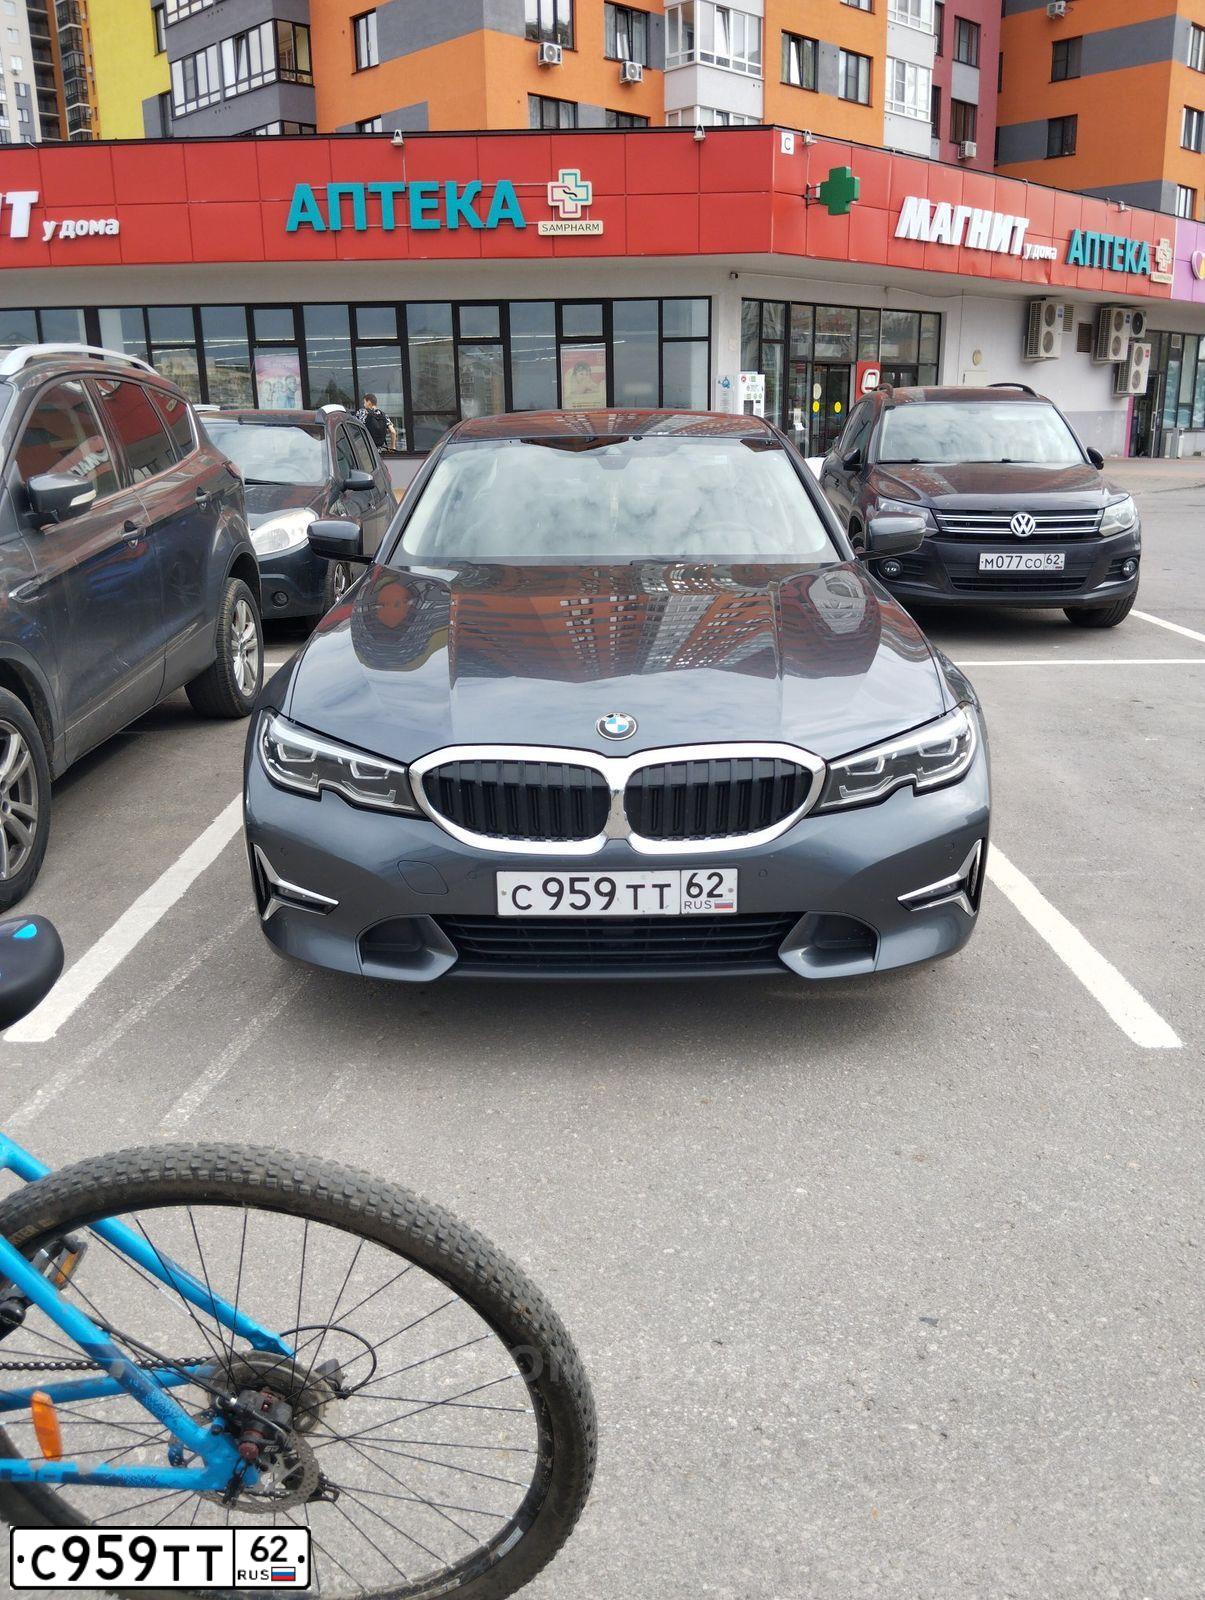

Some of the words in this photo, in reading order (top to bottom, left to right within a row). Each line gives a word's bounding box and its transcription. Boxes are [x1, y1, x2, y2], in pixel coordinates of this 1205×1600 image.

[286, 180, 526, 232] АПТЕКА
[59, 218, 120, 239] дома
[541, 222, 600, 233] SAMPHARM
[894, 195, 1030, 256] МАГНИТ
[1066, 228, 1151, 276] АПТЕКА
[1046, 554, 1060, 565] 62
[685, 871, 724, 899] 62
[684, 900, 712, 910] RUS
